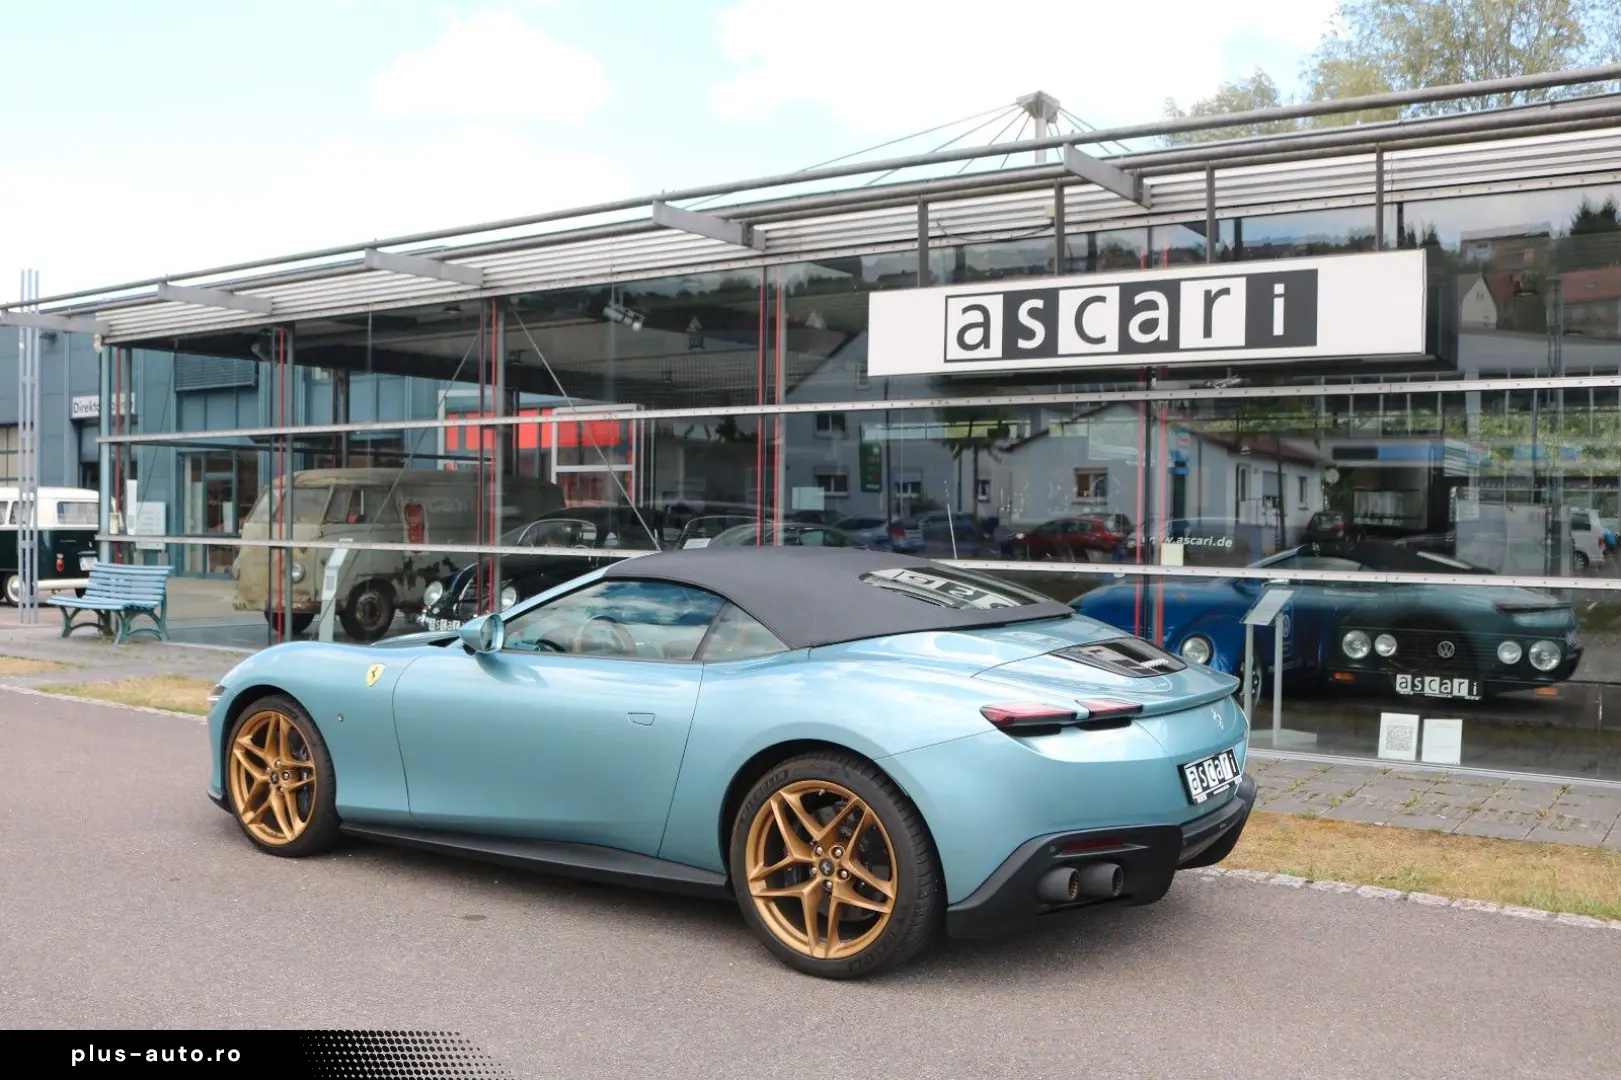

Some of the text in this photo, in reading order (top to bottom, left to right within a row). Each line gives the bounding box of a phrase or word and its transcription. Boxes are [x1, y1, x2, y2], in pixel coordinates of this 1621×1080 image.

[955, 282, 1286, 352] ascari
[1398, 676, 1478, 695] ascari
[1187, 753, 1237, 792] ascari
